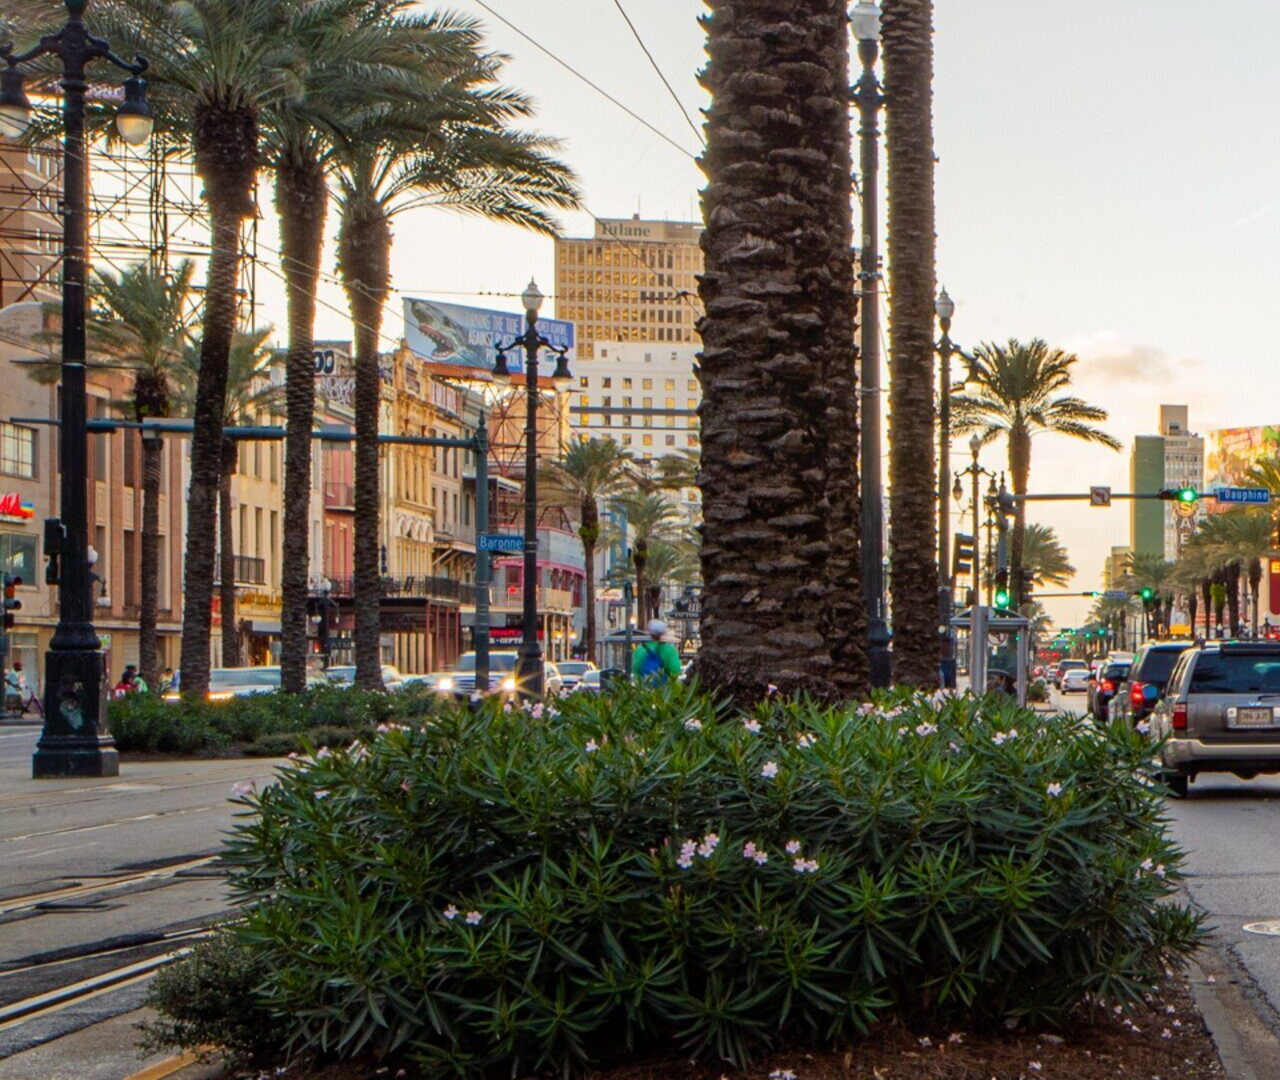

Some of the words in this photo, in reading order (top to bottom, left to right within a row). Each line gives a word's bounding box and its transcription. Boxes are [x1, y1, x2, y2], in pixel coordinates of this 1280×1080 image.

[601, 222, 651, 237] Tulane
[1225, 489, 1268, 502] Dauphine
[480, 536, 522, 549] Baronne
